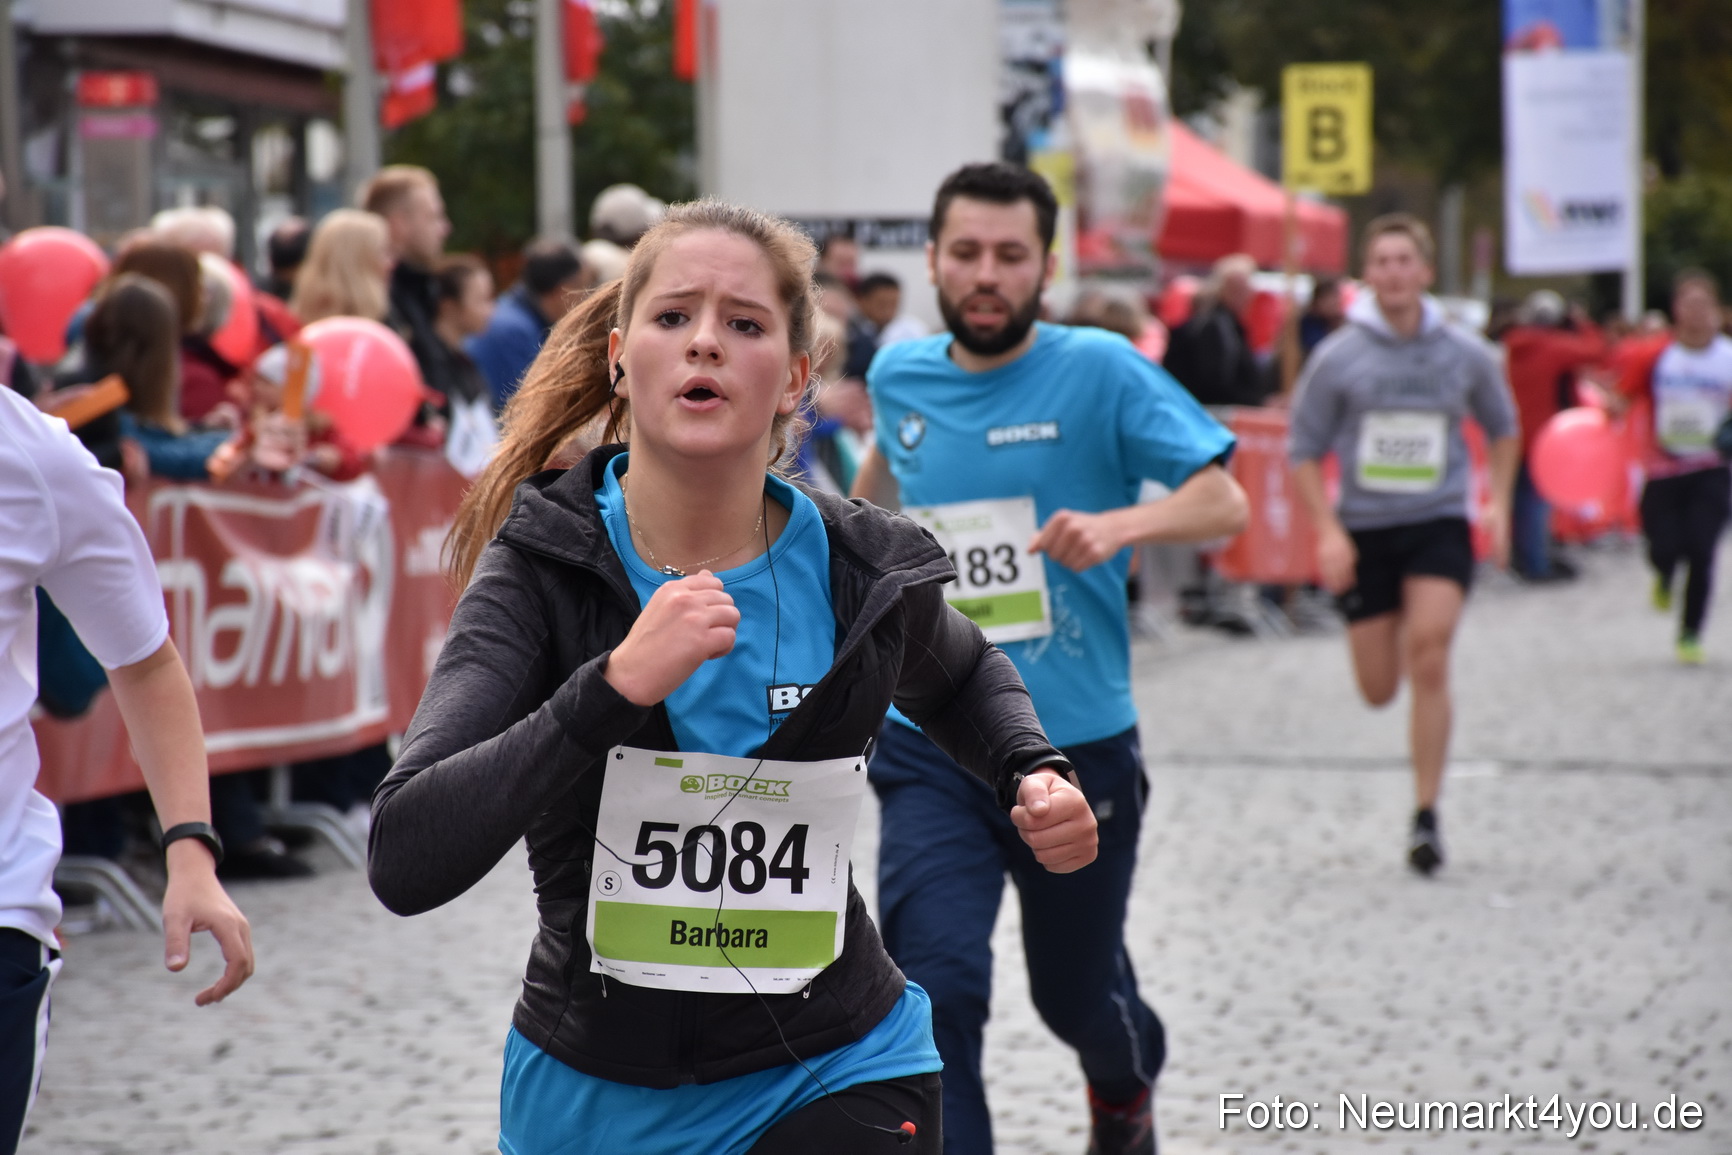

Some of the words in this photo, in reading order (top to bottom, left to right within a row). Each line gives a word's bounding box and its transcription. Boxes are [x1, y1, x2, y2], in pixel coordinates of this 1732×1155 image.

[1308, 106, 1345, 163] B
[987, 421, 1060, 446] BOCK
[945, 543, 1020, 590] 183
[704, 792, 727, 800] inspired
[706, 774, 792, 796] BOCK
[632, 821, 809, 894] 5084
[604, 877, 613, 890] S
[670, 920, 768, 949] Barbara
